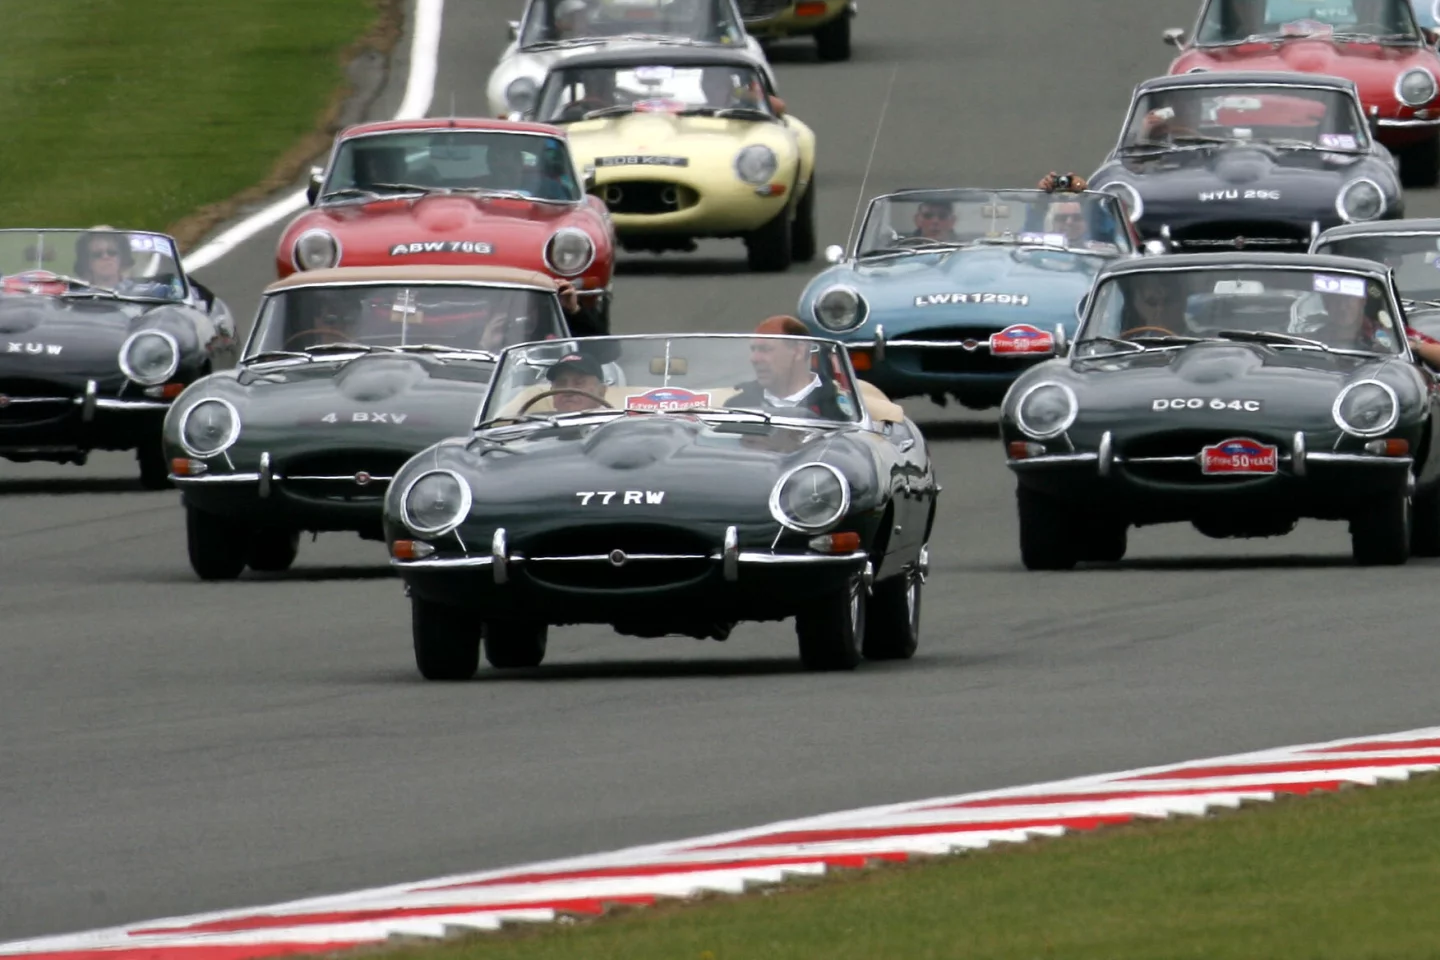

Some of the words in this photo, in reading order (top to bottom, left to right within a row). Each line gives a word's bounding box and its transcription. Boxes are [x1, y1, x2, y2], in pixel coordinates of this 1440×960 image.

[391, 242, 445, 256] ABW
[915, 293, 967, 307] LWR
[1152, 398, 1204, 411] DCO
[1209, 398, 1260, 412] 64C
[321, 412, 337, 423] 4
[1232, 455, 1250, 468] 50
[575, 491, 617, 506] 77
[623, 490, 665, 505] RW
